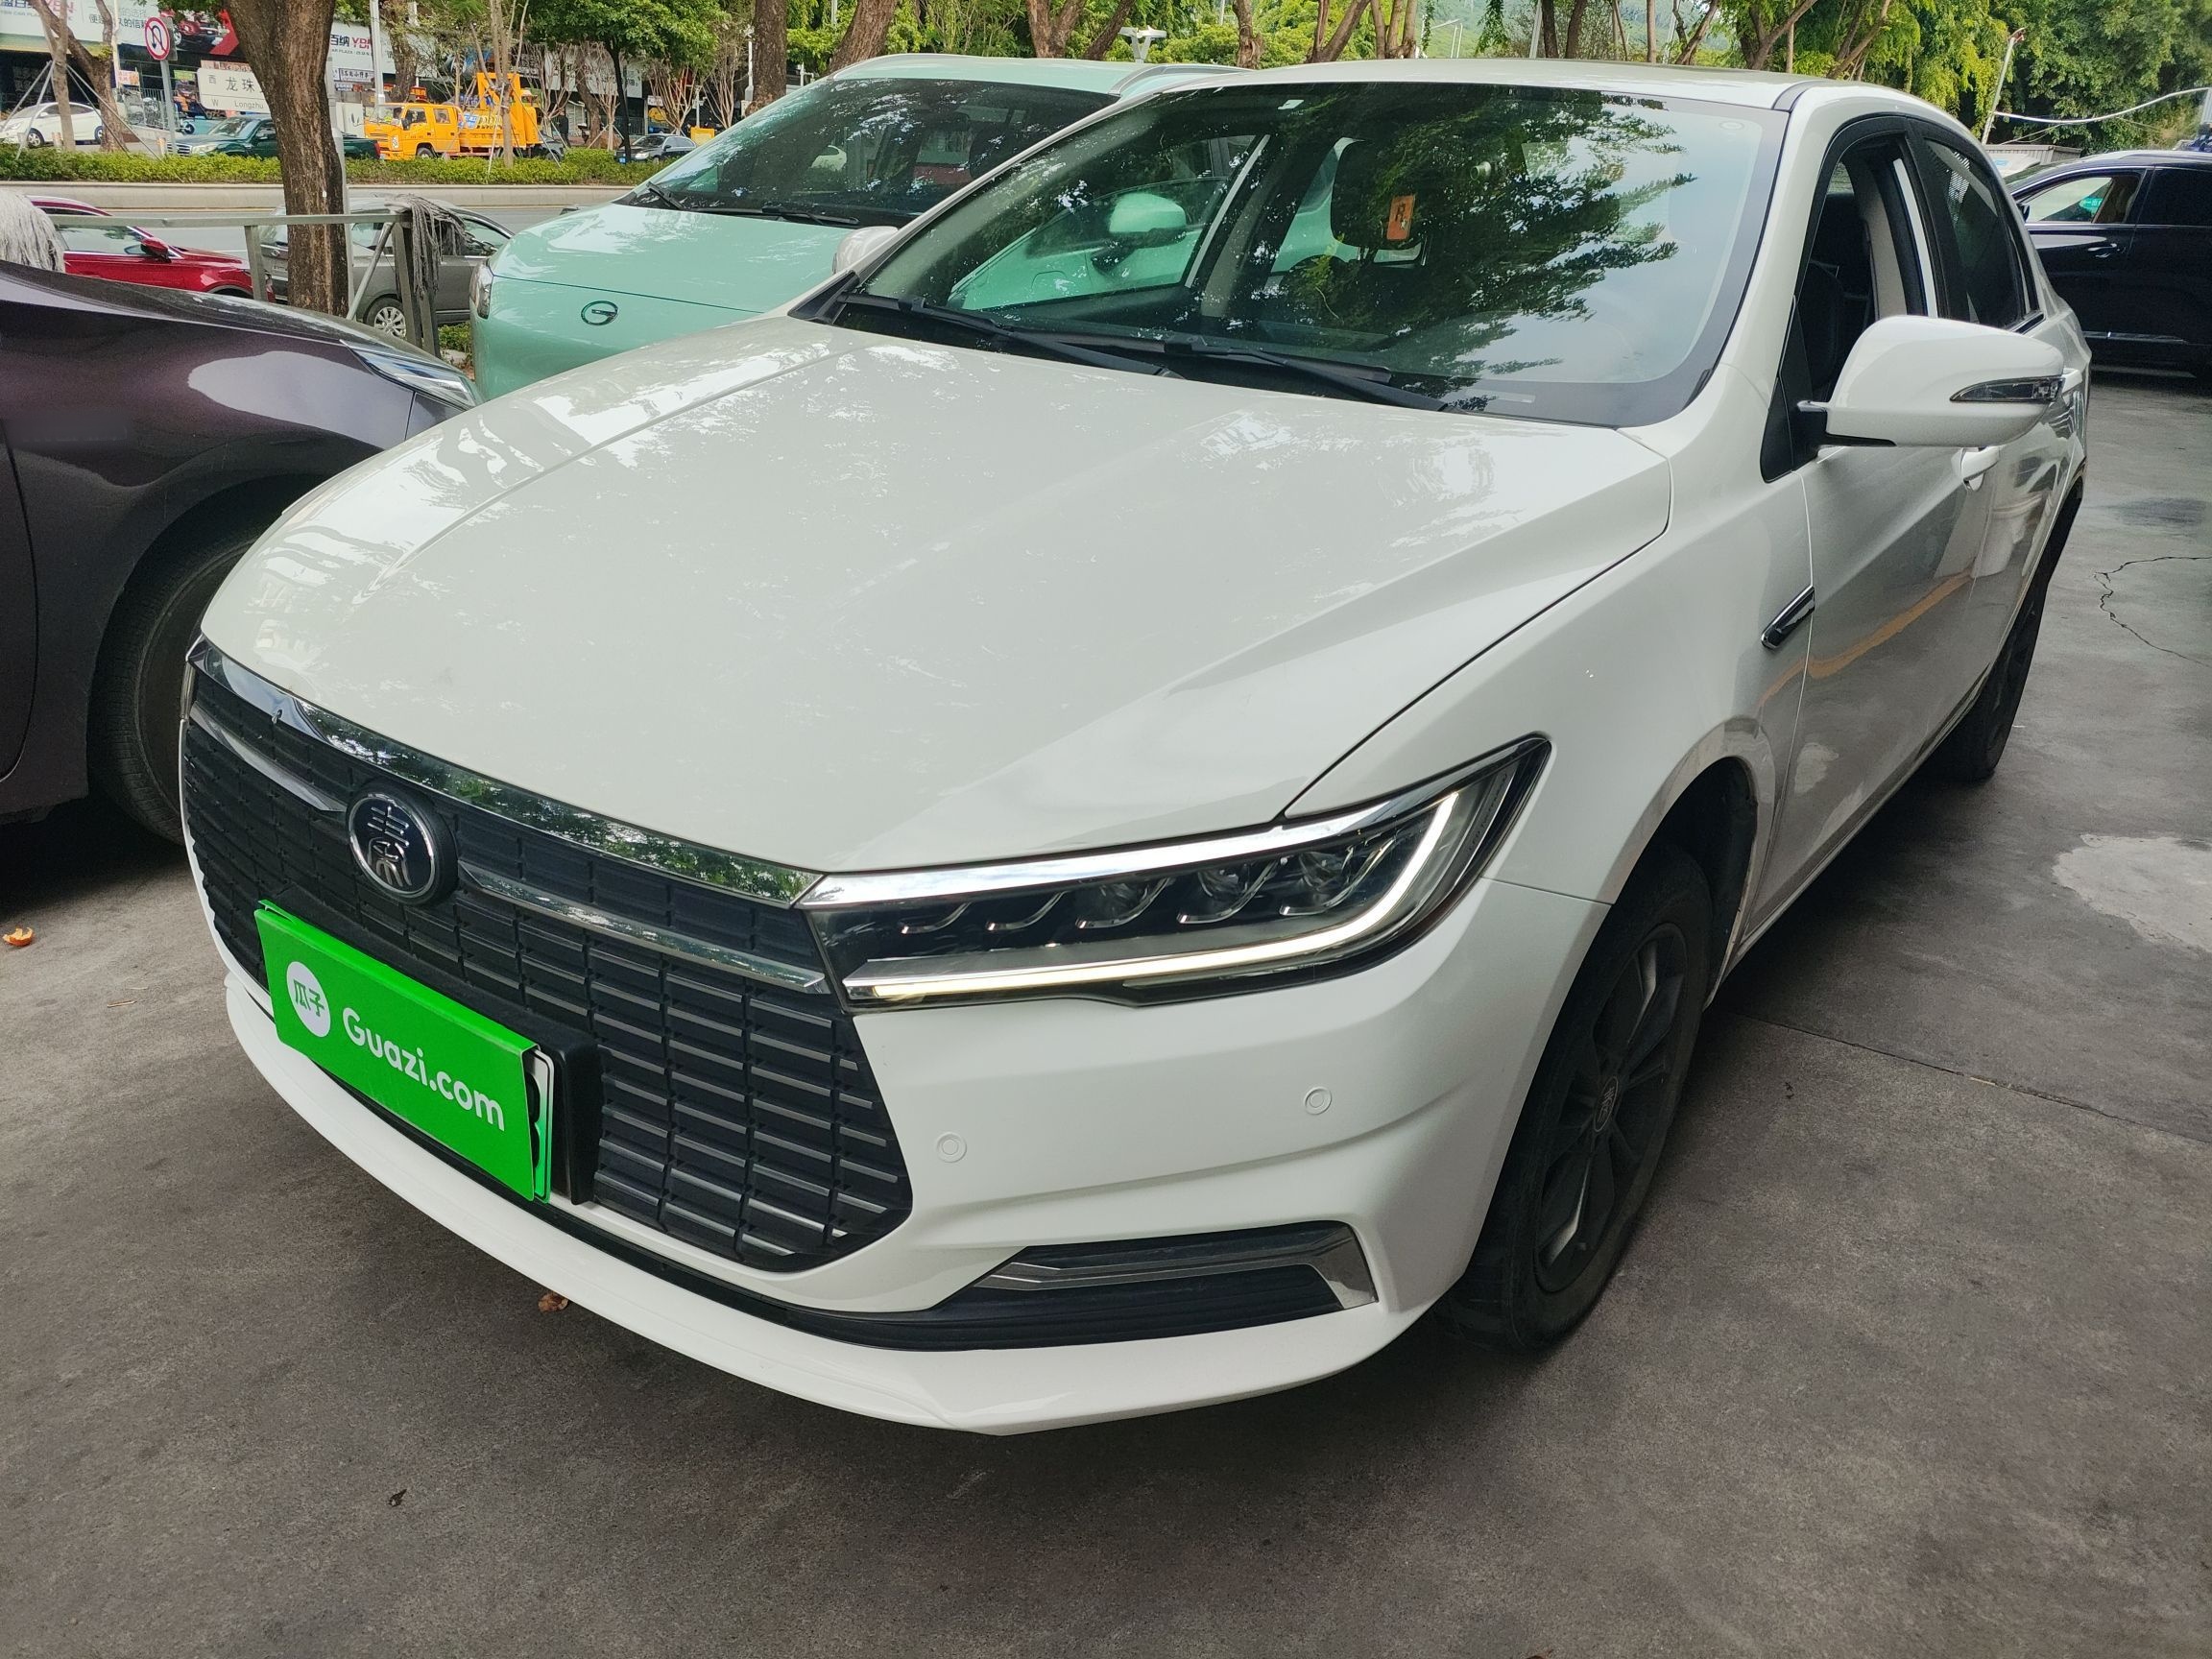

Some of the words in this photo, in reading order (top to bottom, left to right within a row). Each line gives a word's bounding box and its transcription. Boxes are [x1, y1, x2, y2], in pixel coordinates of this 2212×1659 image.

[207, 74, 217, 84] 西
[225, 76, 259, 93] 龙珠
[211, 98, 219, 108] W
[234, 101, 264, 110] Longzhu
[293, 978, 325, 1018] 瓜子
[341, 1006, 506, 1133] Guazi.com
